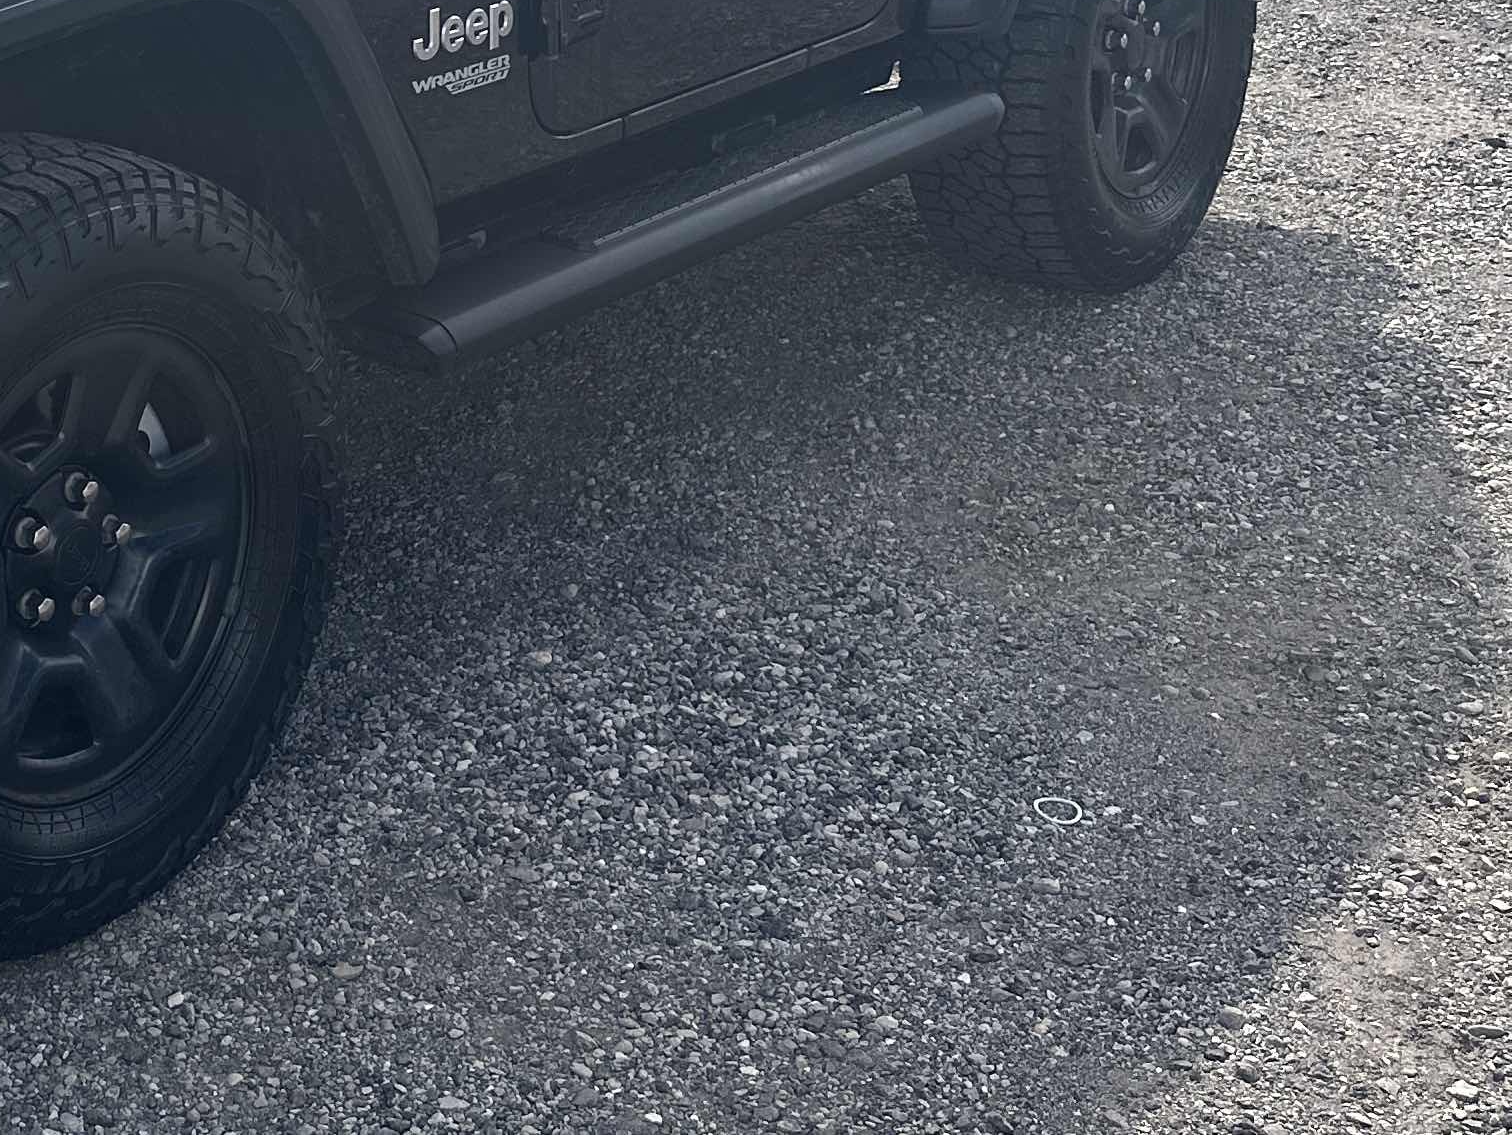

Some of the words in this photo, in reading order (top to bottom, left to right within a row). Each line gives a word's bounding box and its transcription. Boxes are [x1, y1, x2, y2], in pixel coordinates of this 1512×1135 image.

[413, 0, 514, 61] Jeep
[412, 54, 511, 94] WRANGLER
[448, 68, 508, 93] SPORT
